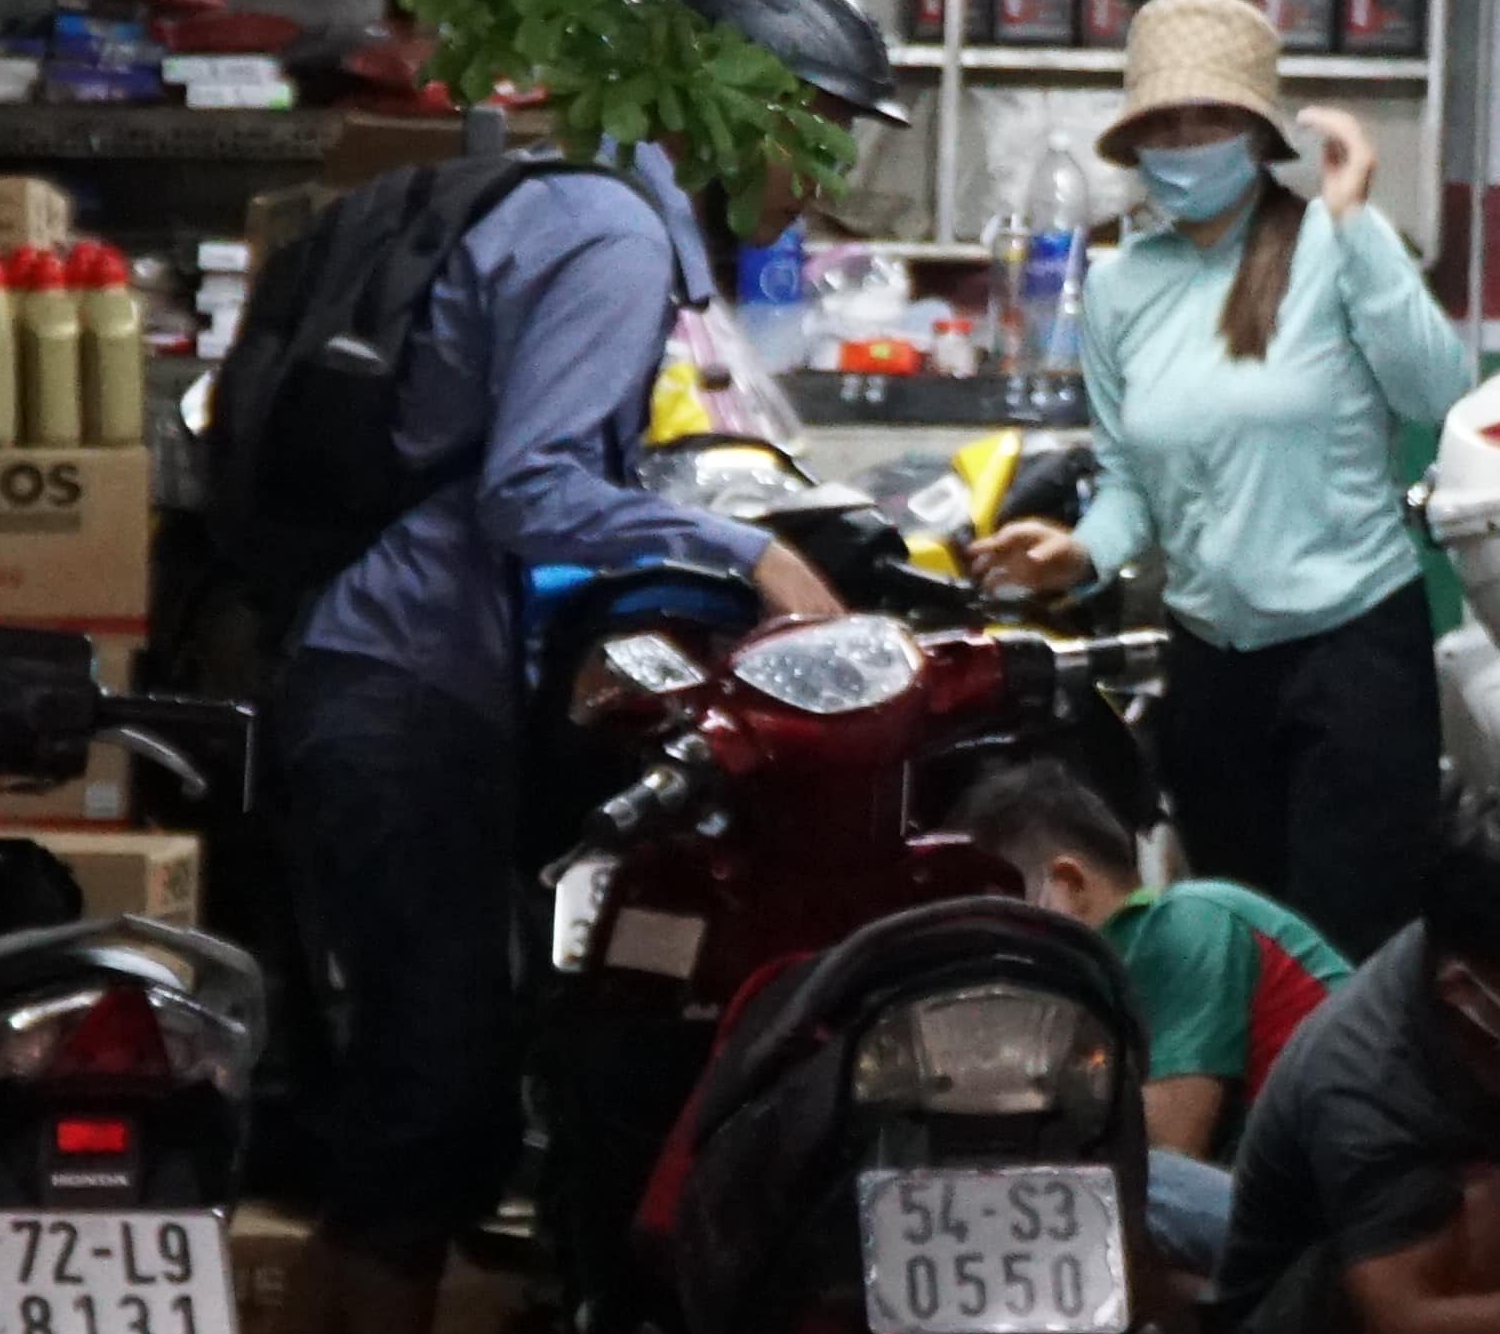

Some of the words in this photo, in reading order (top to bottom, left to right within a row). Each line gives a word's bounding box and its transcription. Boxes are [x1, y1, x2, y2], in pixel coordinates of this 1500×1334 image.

[901, 1180, 1079, 1244] 54-S3
[11, 1220, 193, 1285] 72-L9
[906, 1253, 1085, 1319] 0550
